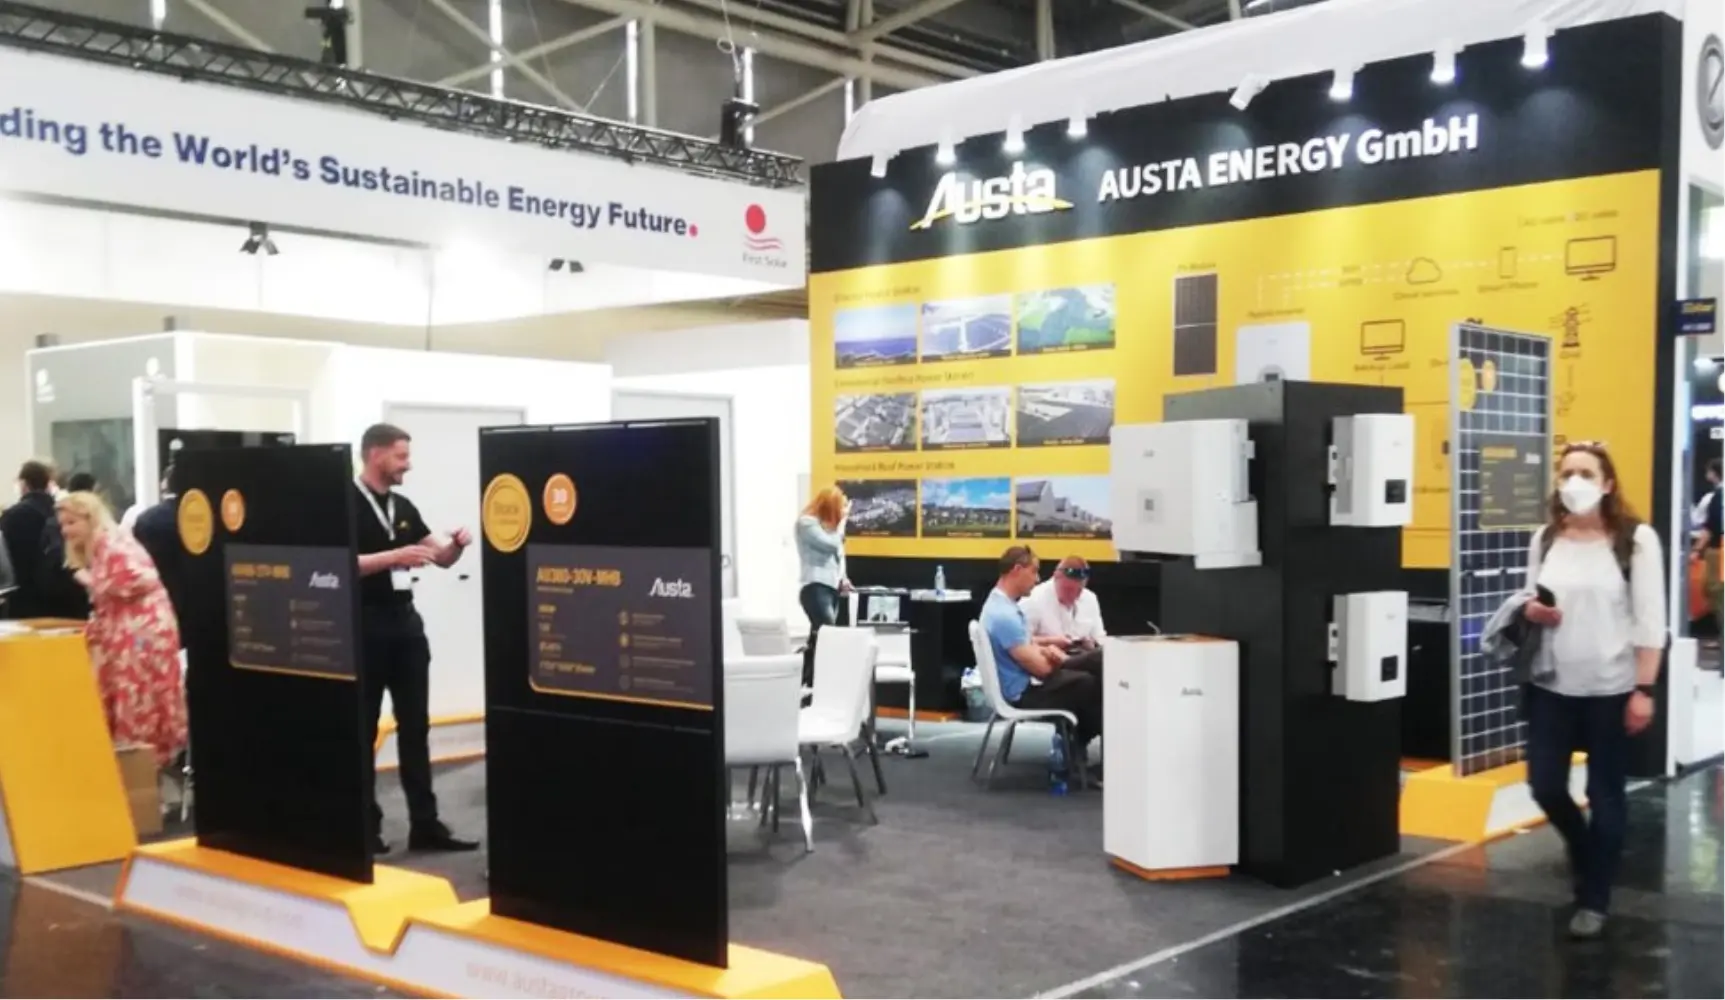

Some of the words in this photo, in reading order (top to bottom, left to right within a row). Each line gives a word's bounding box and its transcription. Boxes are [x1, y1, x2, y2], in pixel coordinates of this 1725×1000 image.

[0, 108, 87, 155] ding
[99, 122, 162, 158] the
[173, 131, 311, 181] World's
[319, 156, 500, 208] Sustainable
[508, 186, 601, 230] Energy
[609, 201, 699, 238] Future.
[916, 160, 1068, 230] Austa
[1098, 158, 1203, 203] AUSTA
[1208, 132, 1352, 186] ENERGY
[1355, 113, 1480, 165] GmbH
[648, 577, 696, 599] Austa
